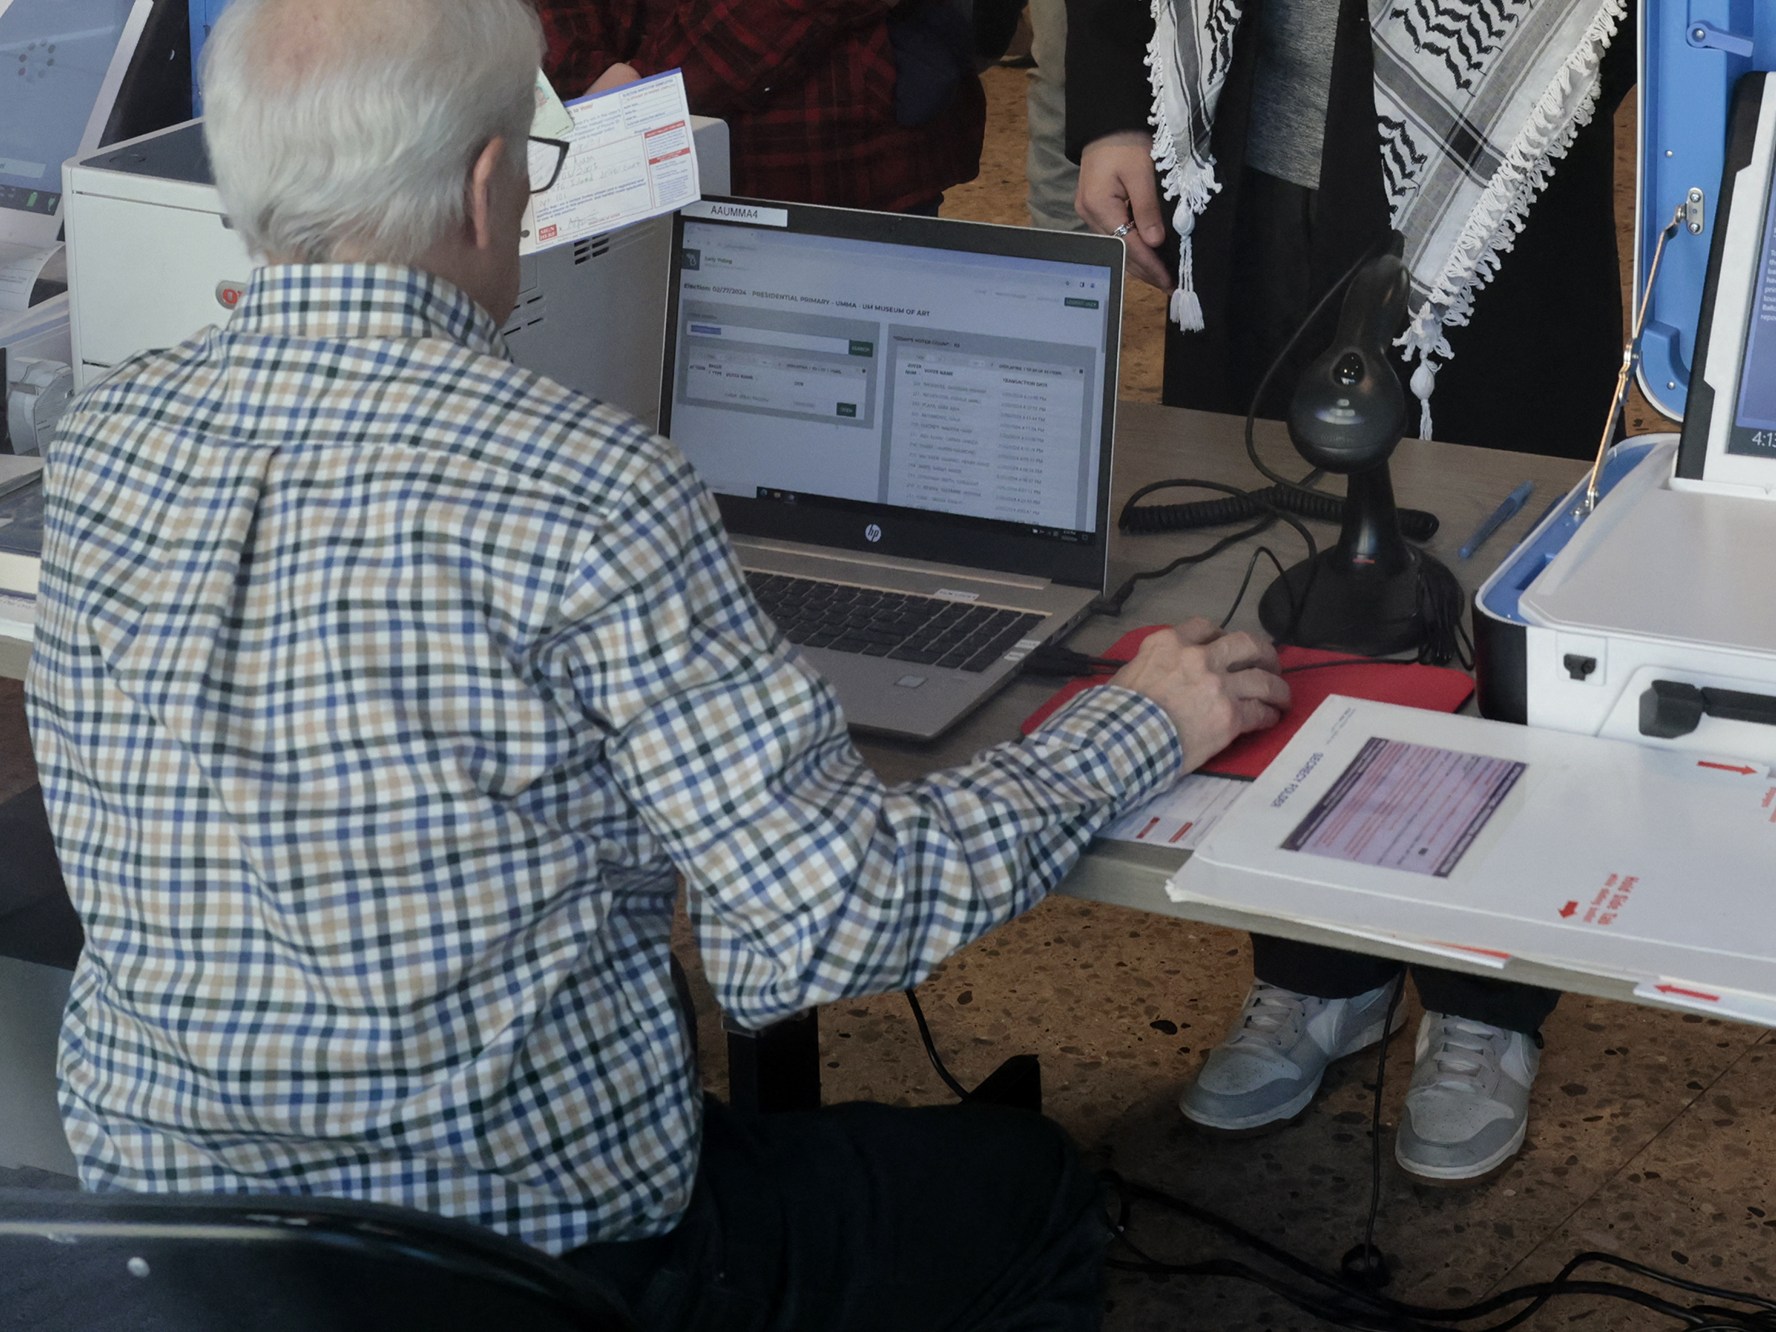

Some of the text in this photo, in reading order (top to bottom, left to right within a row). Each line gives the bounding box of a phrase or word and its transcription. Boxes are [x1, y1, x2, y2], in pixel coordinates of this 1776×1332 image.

[710, 205, 758, 219] AAUMMA4
[683, 282, 711, 291] Election:
[751, 290, 799, 302] PRESIDENTIAL
[799, 296, 830, 305] PRIMARY
[835, 300, 857, 309] UMMA
[874, 305, 905, 314] MUSEUM
[867, 524, 881, 541] hp
[1597, 876, 1640, 925] Hold Side Tab
